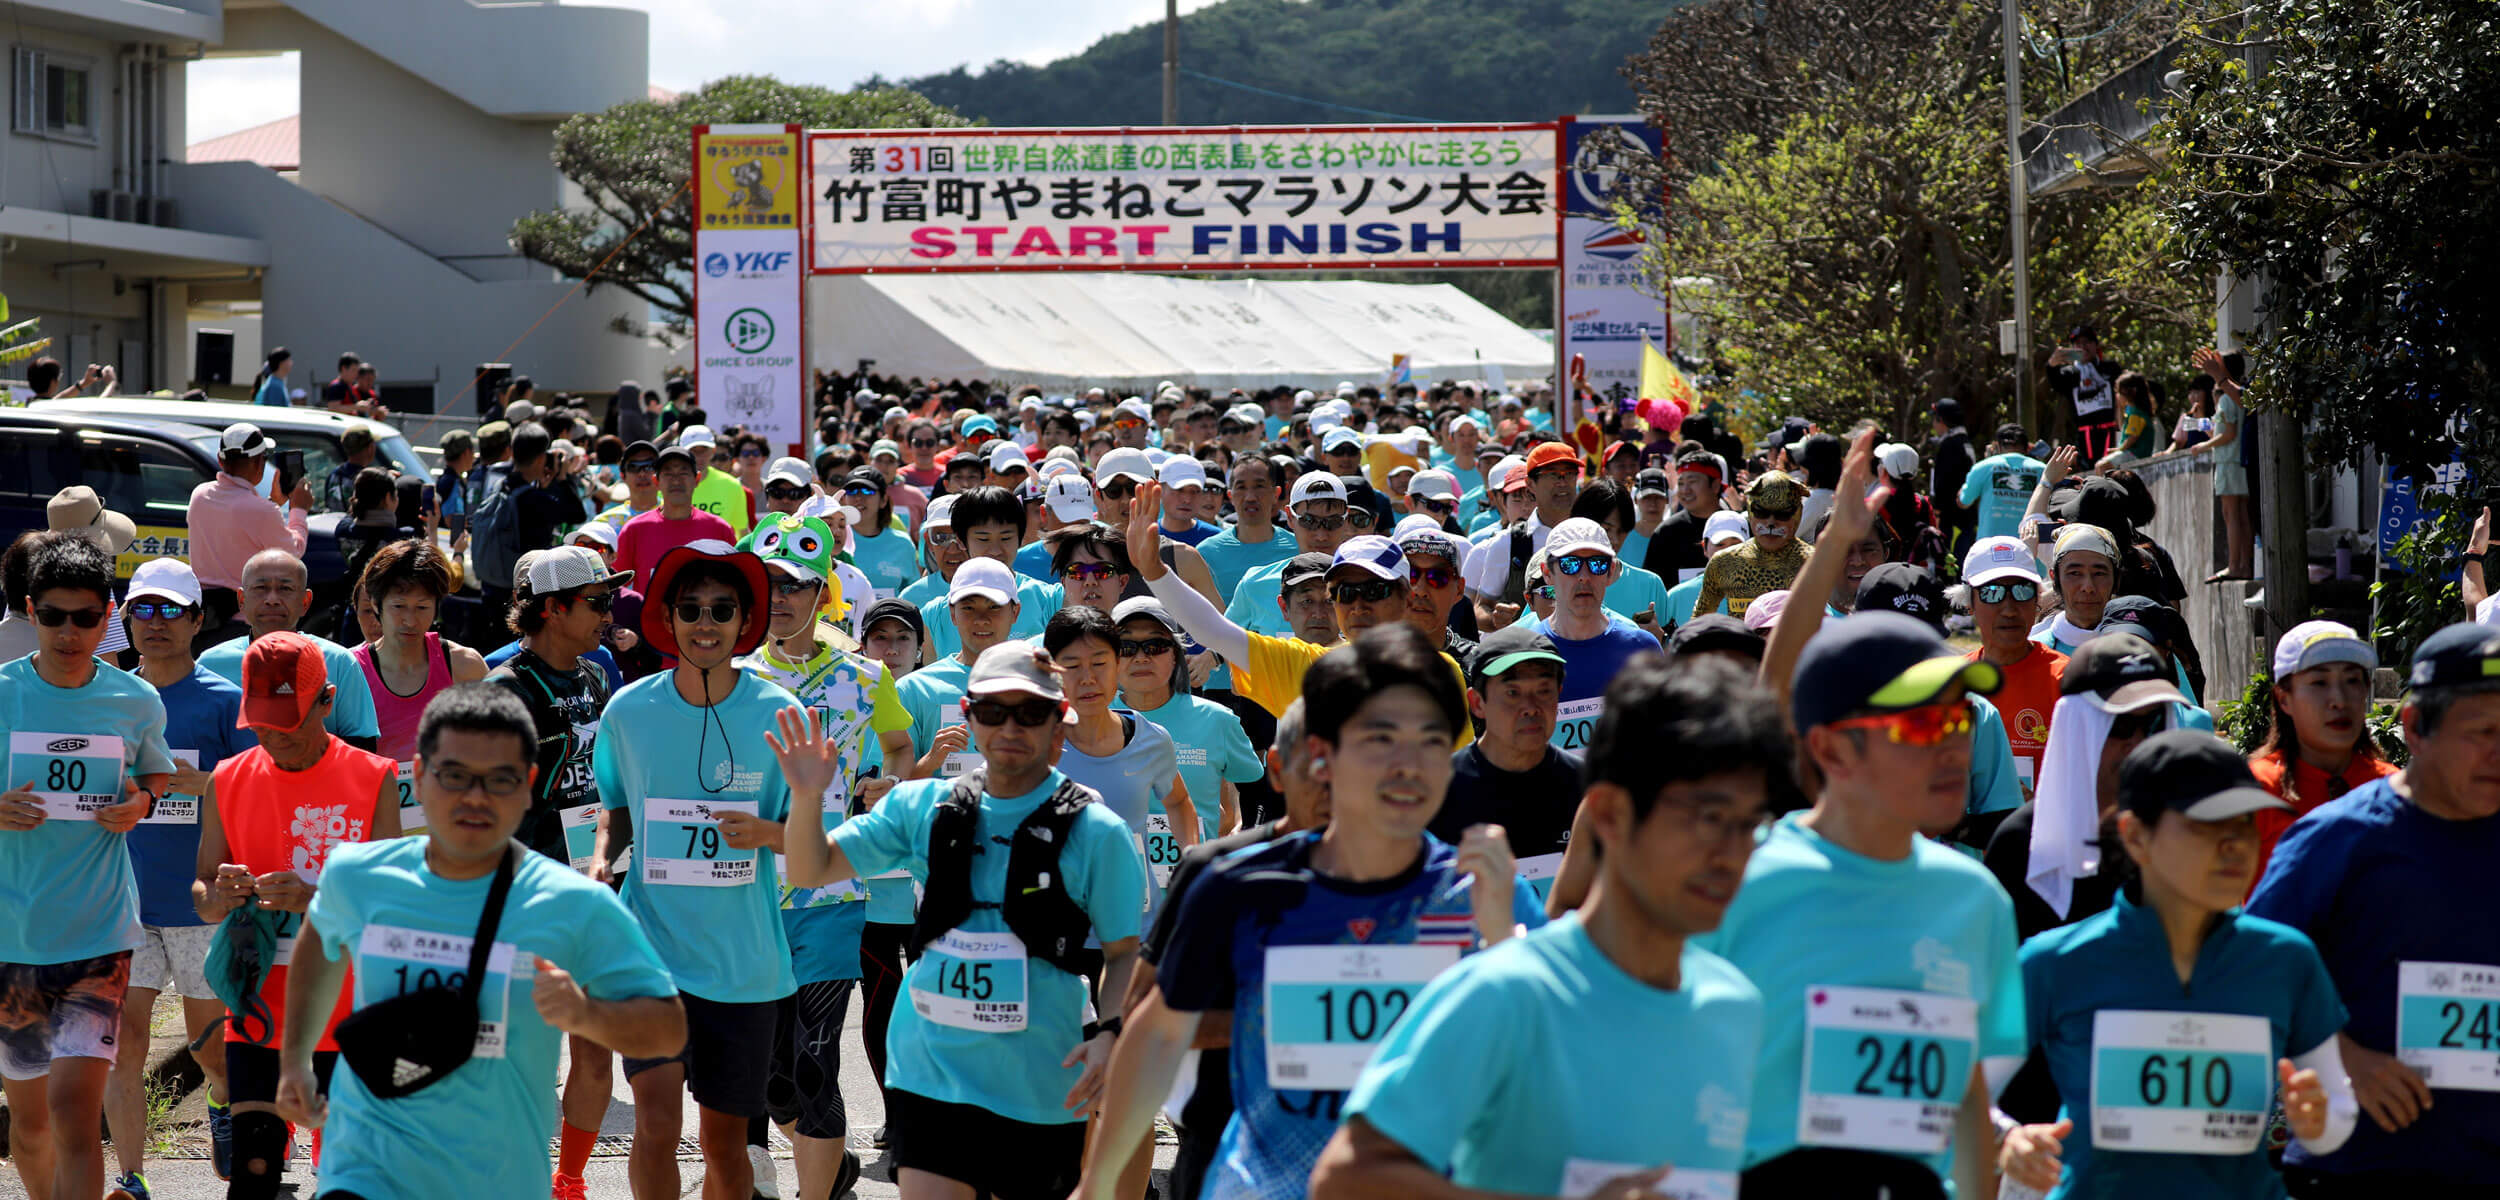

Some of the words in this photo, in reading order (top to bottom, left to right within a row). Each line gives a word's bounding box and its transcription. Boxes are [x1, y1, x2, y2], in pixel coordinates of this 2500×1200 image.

[962, 139, 1523, 172] 世界自然遺産の西表島をさわやかに走ろう
[824, 170, 1547, 224] 竹富町やまねこマラソン大会
[910, 225, 1170, 258] START
[1193, 222, 1462, 255] FINISH
[734, 251, 792, 271] YKF
[705, 357, 741, 367] ONCE
[746, 357, 793, 367] GROUP
[49, 740, 88, 750] KEEN
[47, 759, 86, 792] 80
[682, 826, 719, 859] 79
[711, 870, 753, 878] やまねこマラソン
[938, 959, 993, 1000] 145
[1854, 1036, 1946, 1099] 240
[2140, 1055, 2232, 1107] 610
